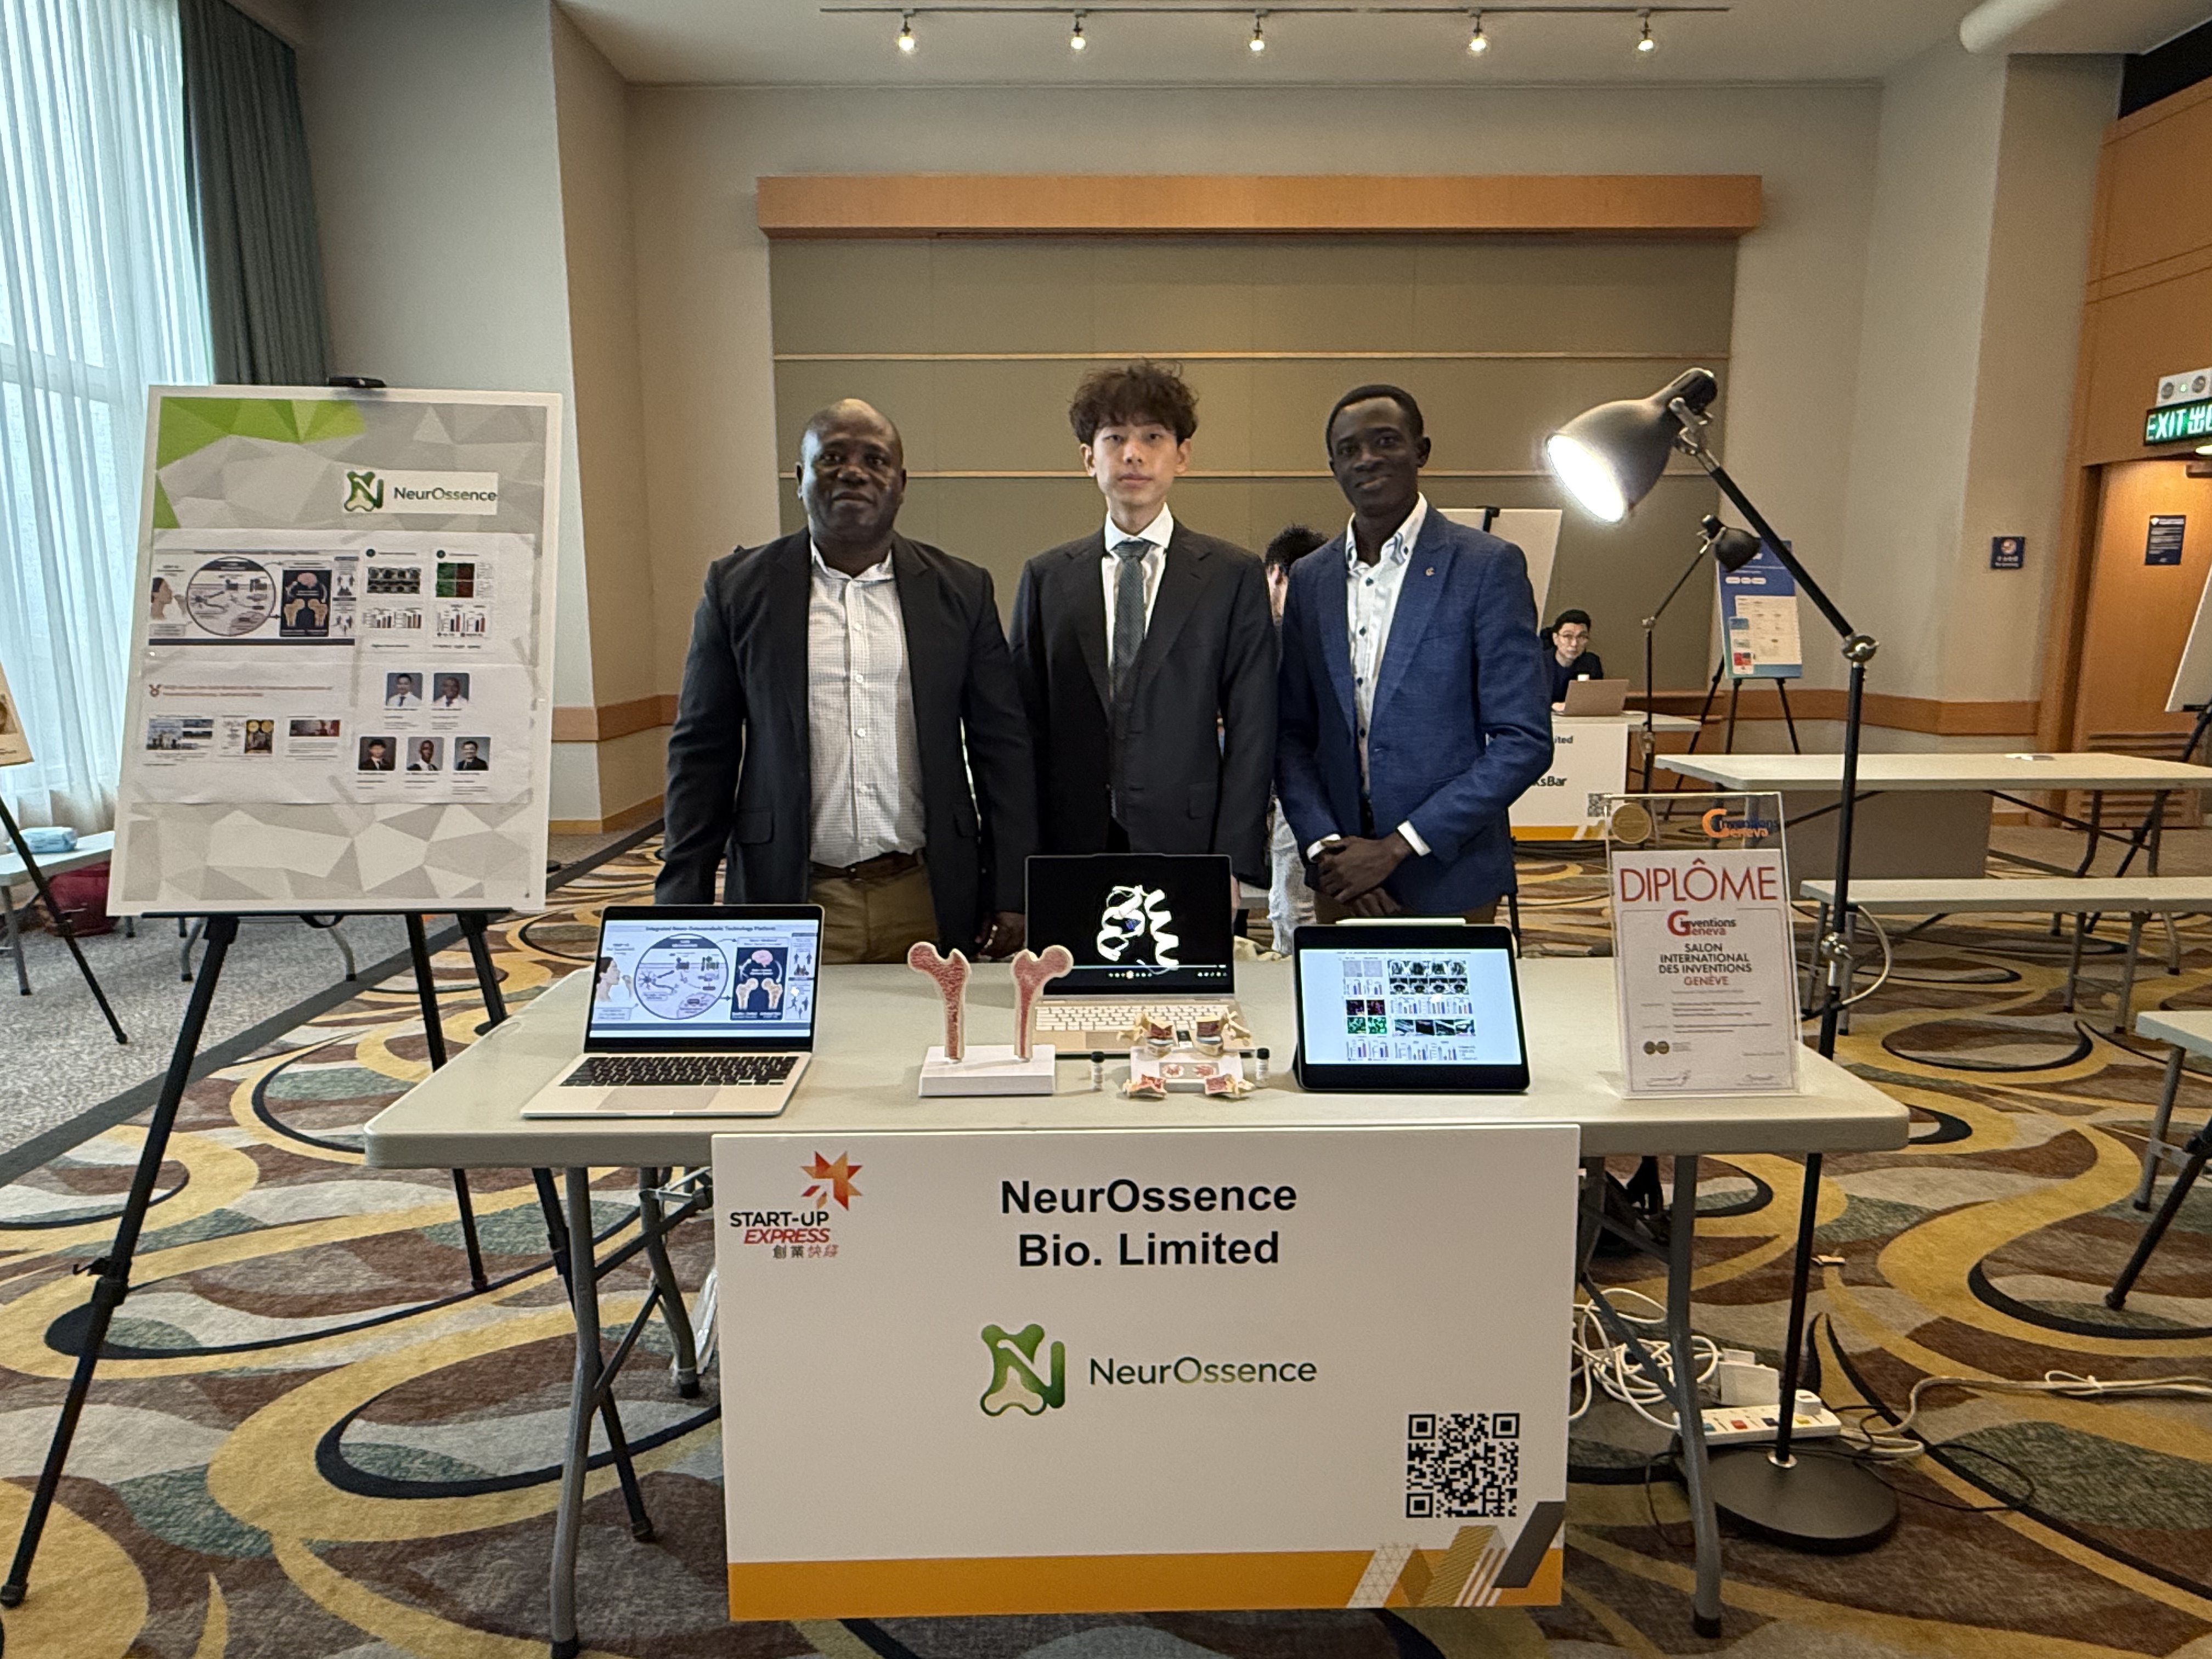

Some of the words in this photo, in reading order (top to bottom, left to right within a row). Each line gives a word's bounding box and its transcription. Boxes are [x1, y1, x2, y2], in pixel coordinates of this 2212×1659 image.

[2146, 409, 2187, 441] EXIT
[393, 487, 496, 501] NeurOssence
[1553, 736, 1573, 744] ited
[1620, 857, 1778, 902] DIPLÔME
[1684, 943, 1723, 953] SALON
[1660, 953, 1750, 963] INTERNATIONAL
[1658, 964, 1680, 974] DES
[1682, 963, 1752, 973] INVENTIONS
[1001, 1178, 1297, 1214] NeurOssence
[730, 1211, 830, 1227] START-UP
[743, 1228, 831, 1244] EXPRESS
[1019, 1234, 1102, 1267] Bio.
[1119, 1231, 1279, 1266] Limited
[1090, 1356, 1317, 1385] NeurOssence
